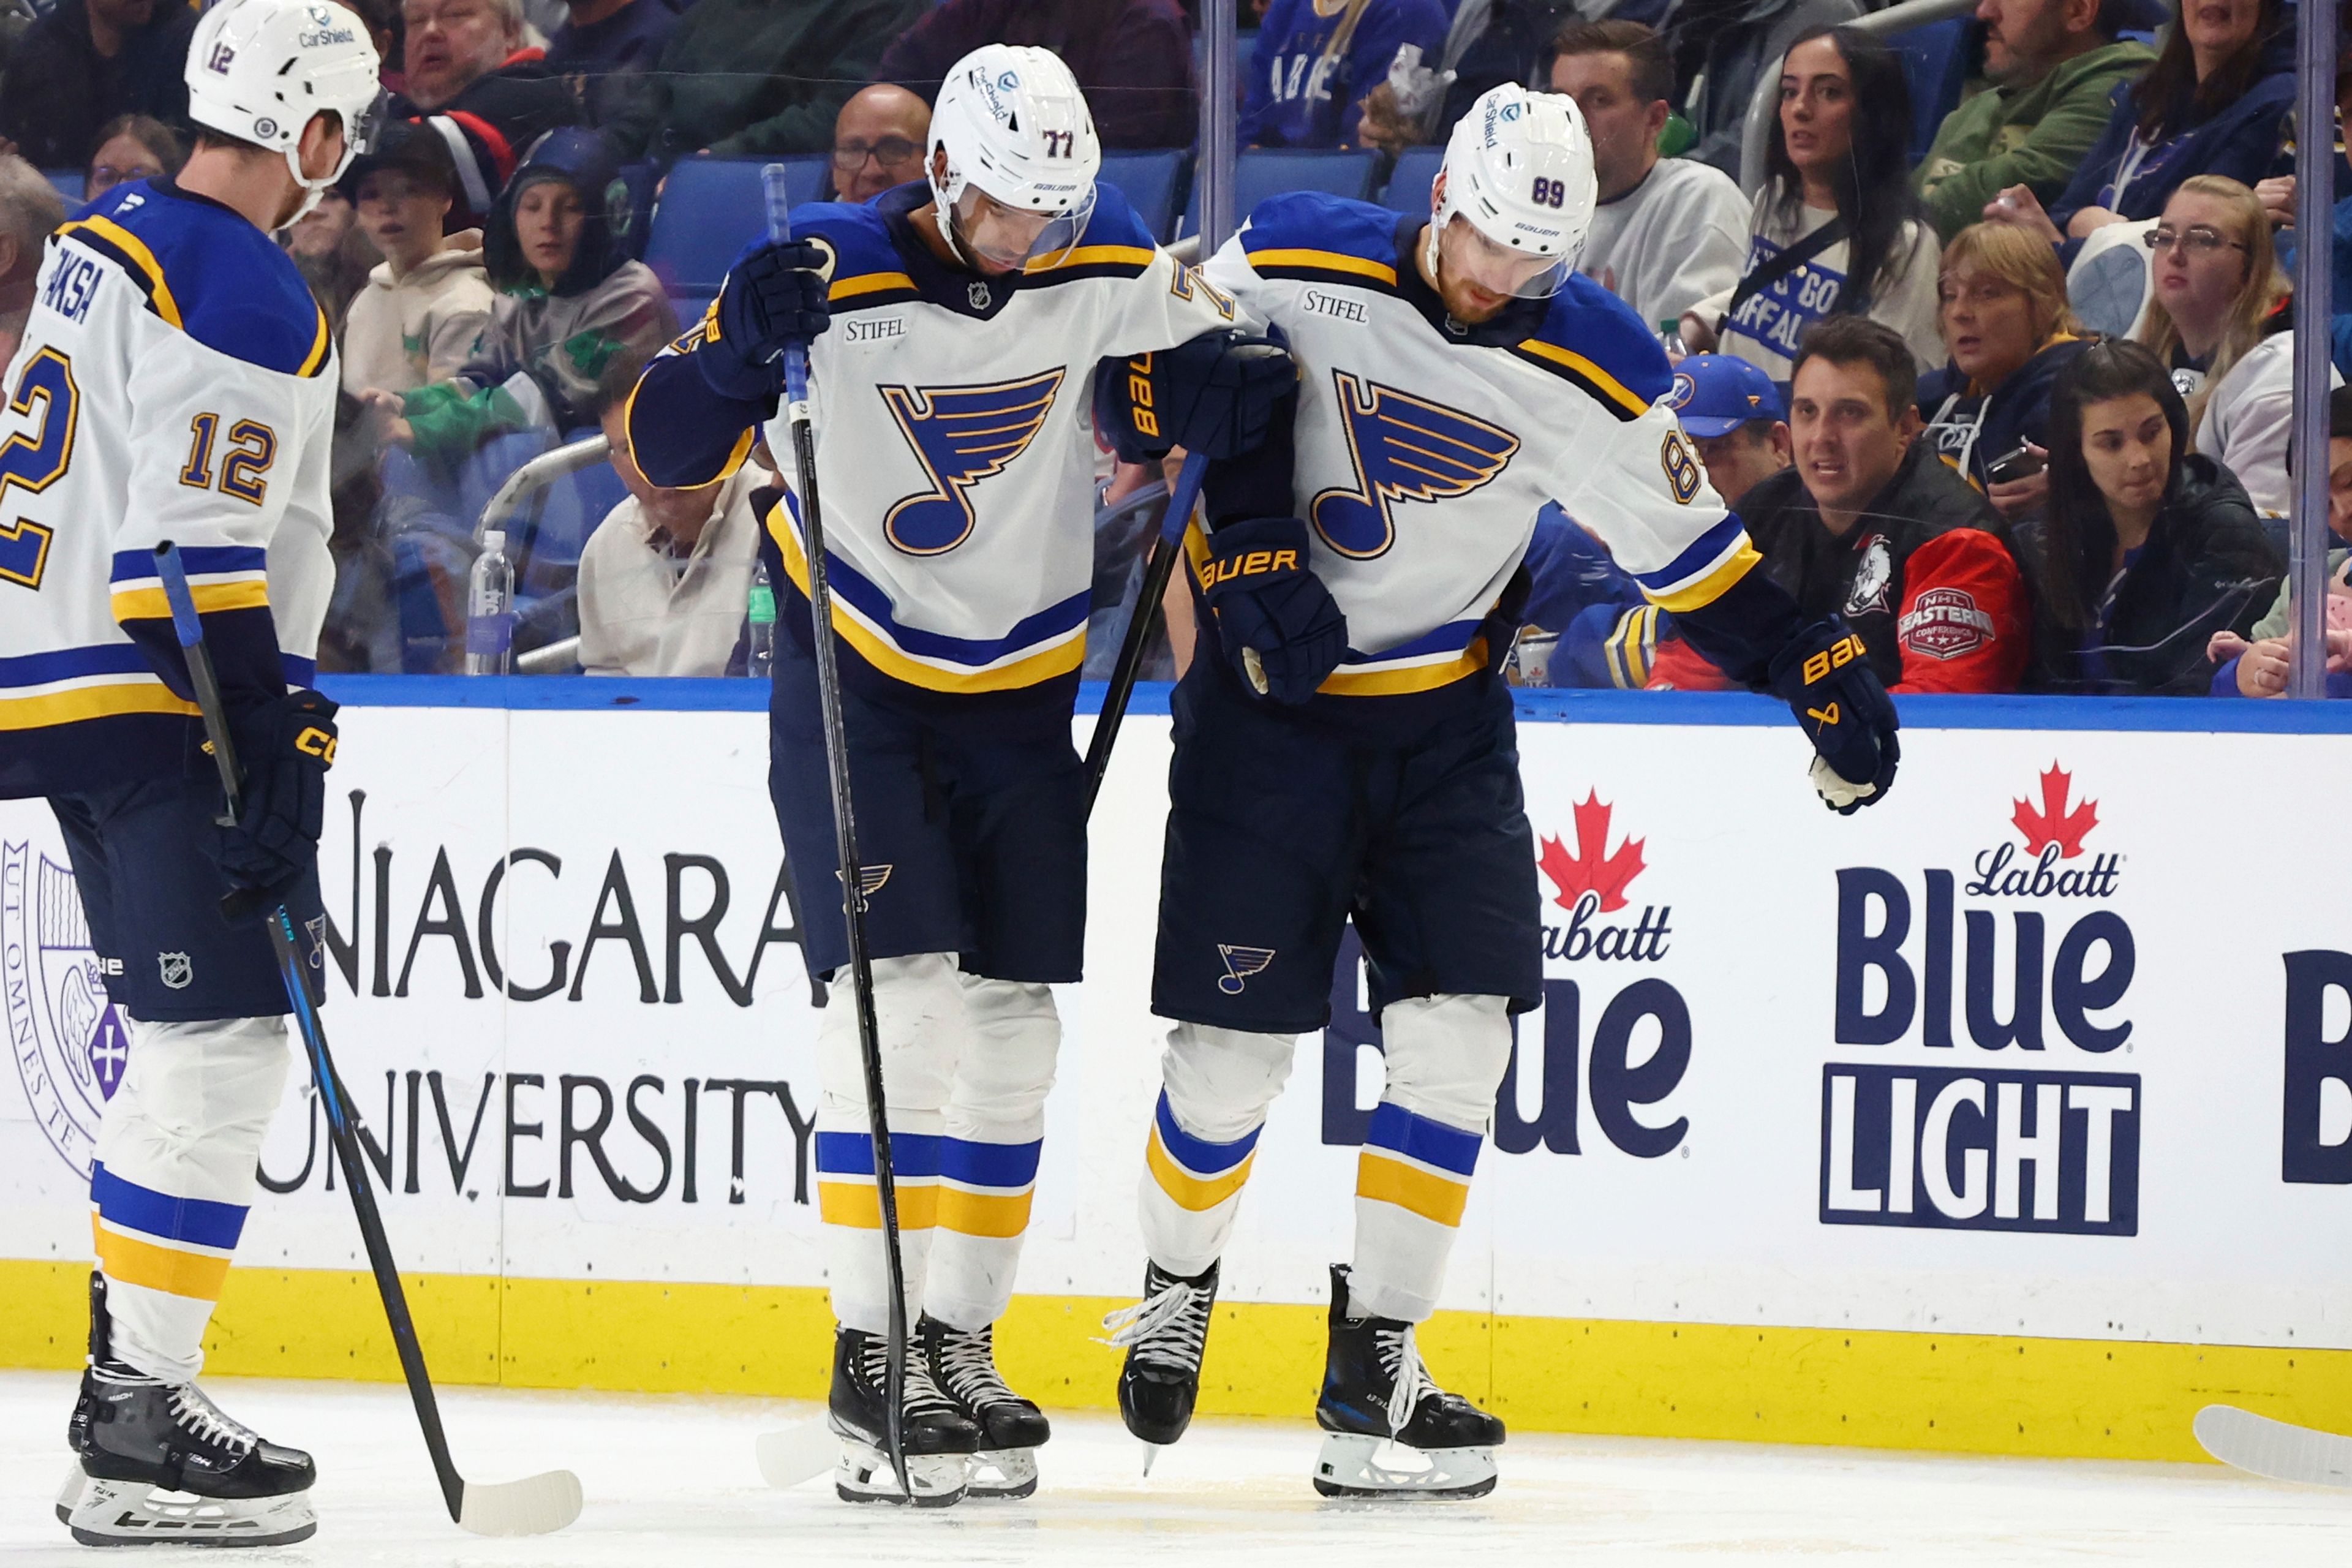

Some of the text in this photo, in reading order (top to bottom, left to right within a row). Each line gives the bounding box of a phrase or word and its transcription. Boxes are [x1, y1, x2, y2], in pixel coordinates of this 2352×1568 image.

[208, 40, 236, 75] 12
[299, 29, 356, 48] CarShield
[1042, 130, 1074, 159] 77
[1485, 93, 1500, 150] CarShield
[1532, 176, 1565, 209] 89
[1304, 290, 1366, 323] STIFEL
[1798, 272, 1840, 314] GO
[846, 318, 906, 341] STIFEL
[179, 412, 278, 507] 12
[1901, 606, 1988, 631] EASTERN
[1925, 595, 1964, 607] NHL
[6, 862, 20, 921] UT
[1964, 842, 2119, 897] Labatt
[322, 789, 828, 1008] NIAGARA
[1541, 894, 1672, 962] abatt
[1835, 867, 2136, 1054] Blue
[7, 943, 46, 1095] OMNES
[1322, 919, 1692, 1159] Bue
[2282, 949, 2352, 1184] B
[255, 1069, 818, 1205] UNIVERSITY
[1828, 1075, 2133, 1223] LIGHT
